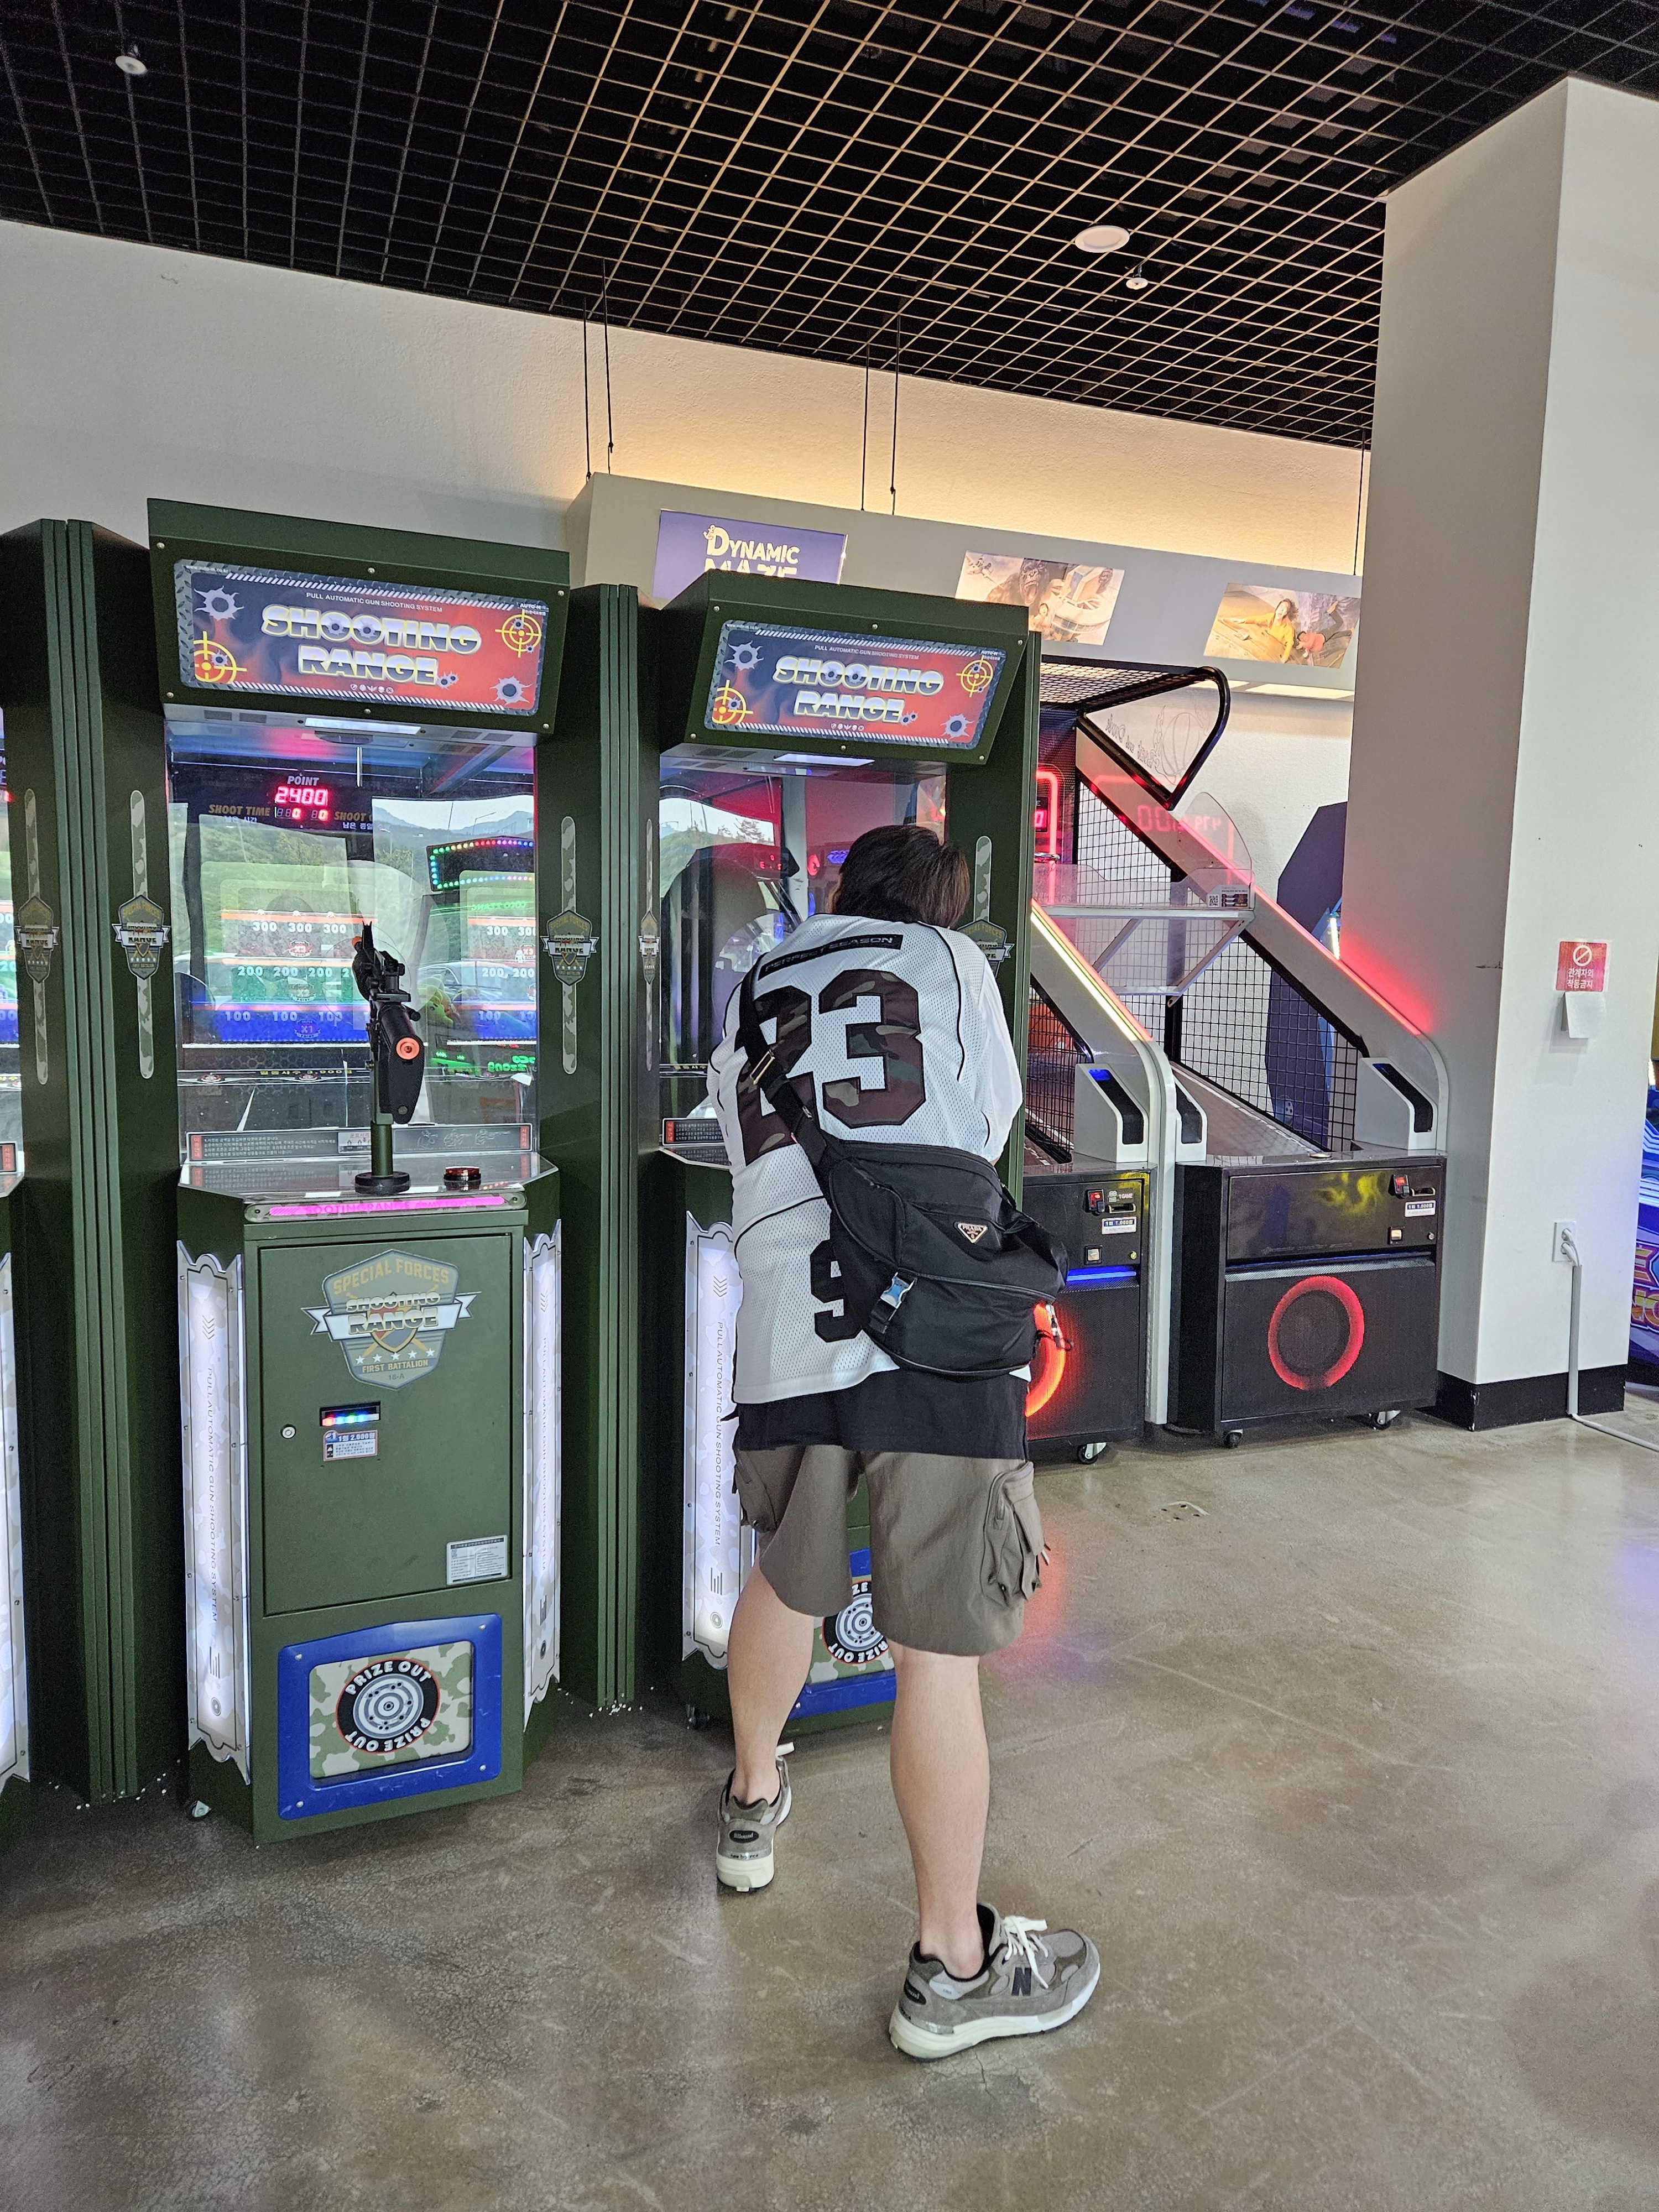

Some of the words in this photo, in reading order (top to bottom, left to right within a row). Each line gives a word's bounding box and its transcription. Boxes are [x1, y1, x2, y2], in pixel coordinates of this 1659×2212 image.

[706, 525, 800, 565] DYNAMIC
[325, 595, 364, 603] AUTOMATIC
[381, 601, 415, 609] SHOOTING
[261, 604, 482, 655] SHOOTING
[298, 644, 439, 686] RANGE
[772, 655, 944, 696] SHOOTING
[793, 690, 905, 723] RANGE
[288, 776, 319, 785] POINT
[275, 786, 327, 806] 2400
[208, 804, 243, 815] SHOOT
[246, 806, 270, 816] TIME
[334, 811, 366, 821] SHOOT
[253, 922, 277, 932] 300
[288, 923, 312, 933] 300
[324, 924, 346, 933] 300
[487, 926, 508, 936] 300
[829, 937, 894, 949] SEASON
[238, 966, 263, 977] 200
[274, 967, 298, 977] 200
[308, 967, 332, 978] 200
[482, 968, 504, 977] 200
[513, 968, 535, 978] 200
[1568, 968, 1594, 978] 관계자외
[1567, 979, 1593, 989] 작동금지
[225, 1011, 251, 1021] 100
[273, 1011, 298, 1022] 100
[319, 1011, 343, 1022] 100
[479, 1011, 501, 1020] 100
[333, 1260, 392, 1294] SPECIAL
[397, 1259, 450, 1285] FORCES
[346, 1291, 440, 1312] SHOOTING
[348, 1307, 439, 1335] RANGE
[362, 1364, 384, 1373] FIRST
[388, 1360, 429, 1370] BATTALION
[828, 1643, 854, 1663] OUT
[858, 1641, 889, 1663] RIZE
[345, 1661, 393, 1695] PRIZE
[398, 1660, 431, 1682] OUT
[345, 1732, 379, 1752] OUT
[384, 1718, 430, 1752] PRIZE
[1011, 1967, 1032, 1996] N
